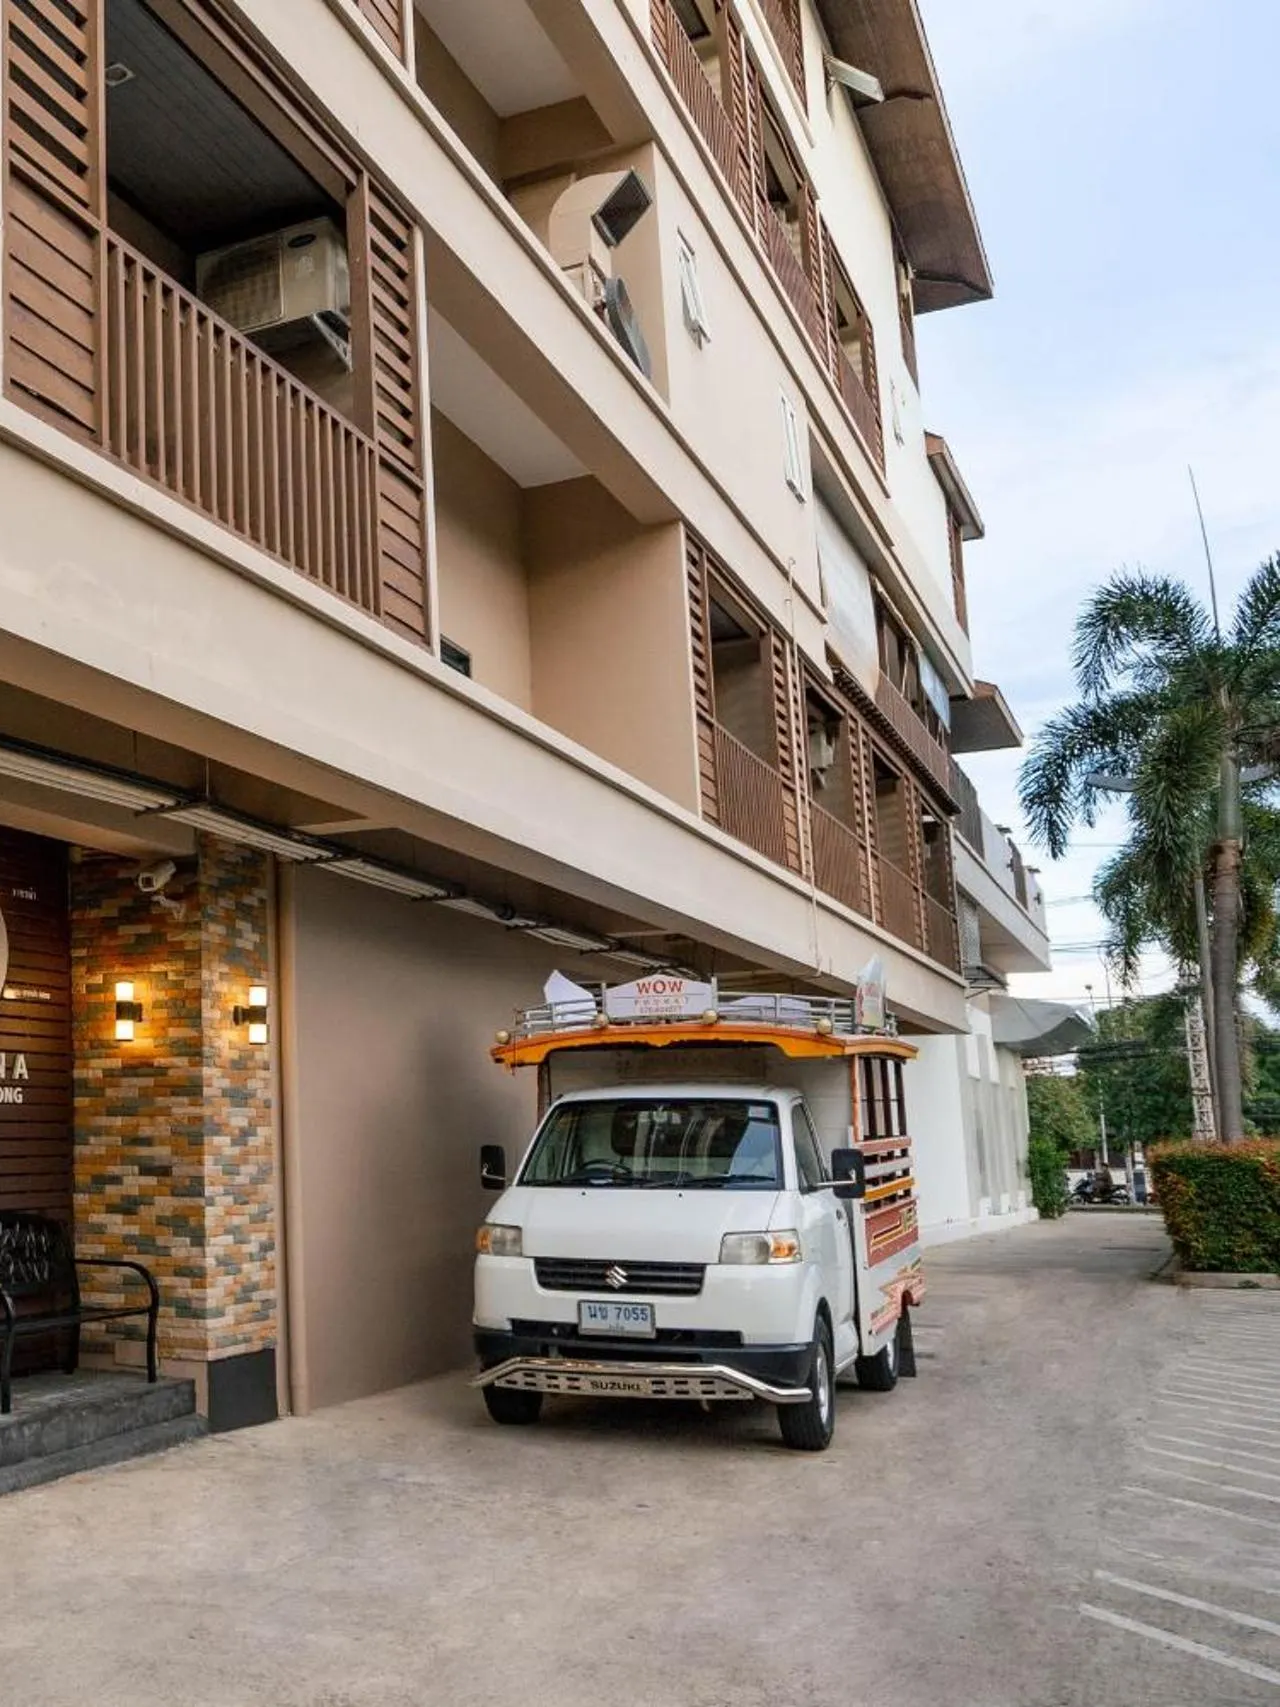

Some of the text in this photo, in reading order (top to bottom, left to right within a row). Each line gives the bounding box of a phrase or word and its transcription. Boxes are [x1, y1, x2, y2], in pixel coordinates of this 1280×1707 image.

[636, 980, 684, 995] WOW
[614, 1306, 649, 1322] 7055
[589, 1380, 641, 1392] SUZUKI
